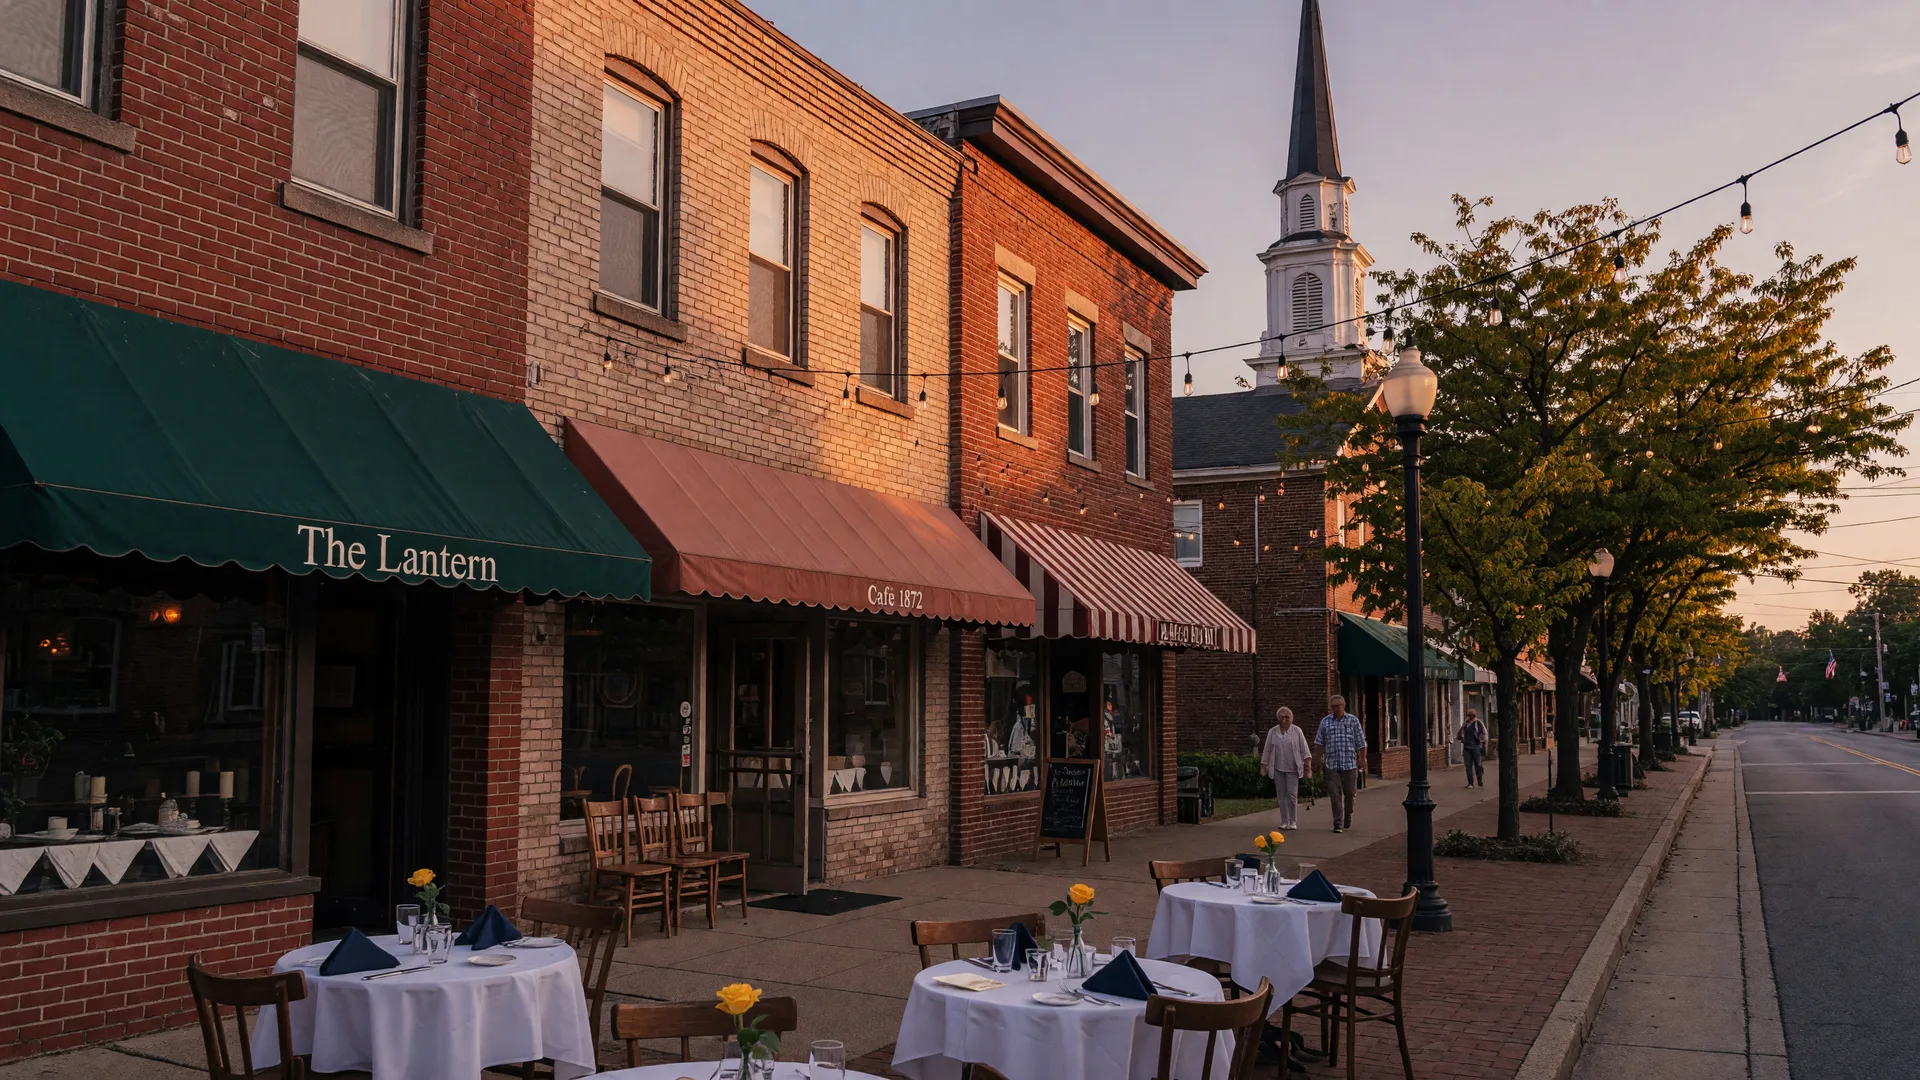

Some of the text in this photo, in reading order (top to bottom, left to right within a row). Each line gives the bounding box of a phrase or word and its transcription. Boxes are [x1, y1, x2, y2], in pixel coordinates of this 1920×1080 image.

[298, 524, 499, 582] The Lantern
[899, 589, 923, 610] 1872
